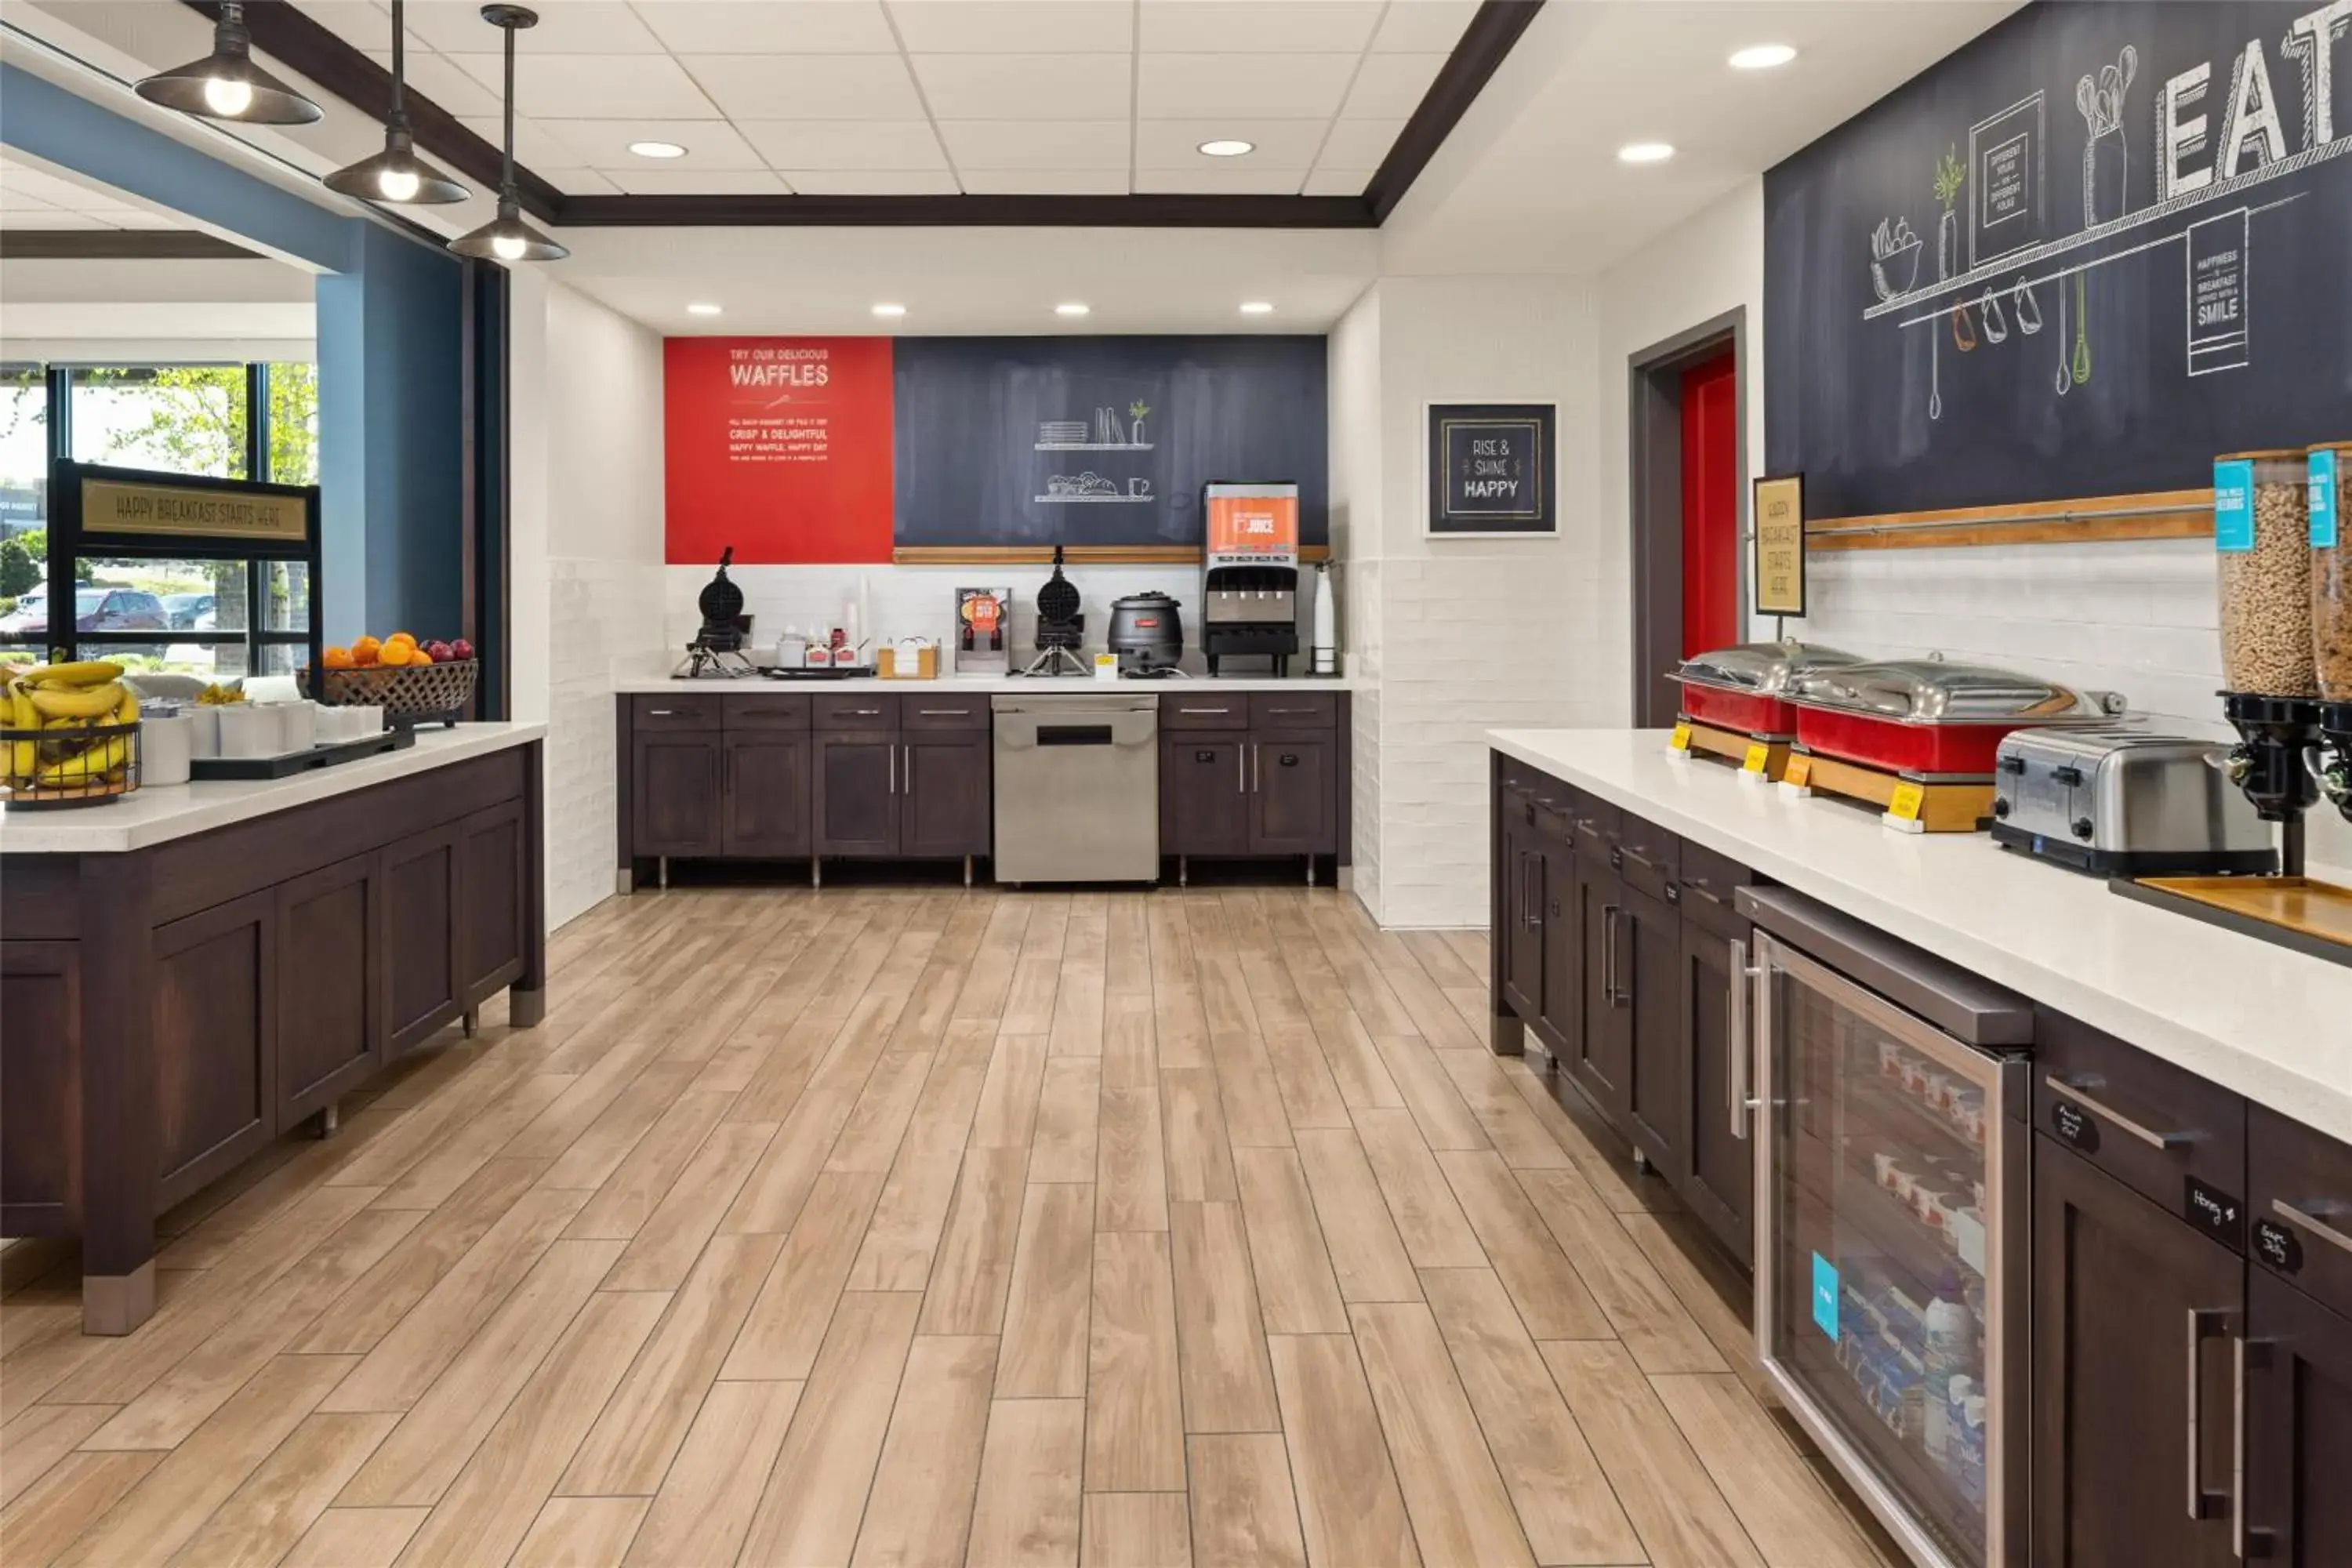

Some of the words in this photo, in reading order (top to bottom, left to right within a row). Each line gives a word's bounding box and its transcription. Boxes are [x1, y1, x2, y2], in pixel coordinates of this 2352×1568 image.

[2156, 0, 2352, 203] EAT
[2198, 249, 2238, 270] HAPPINESS
[2198, 274, 2237, 294] BREAKFAST
[2198, 297, 2238, 325] SMILE
[730, 350, 749, 360] TRY
[753, 350, 775, 360] OUR
[778, 350, 829, 360] DELICIOUS
[730, 364, 829, 387] WAFFLES
[729, 429, 758, 440] CRISP
[771, 429, 827, 440] DELIGHTFUL
[1473, 440, 1497, 456] RISE
[1500, 439, 1510, 456] &
[1475, 459, 1507, 476] SHINE
[1465, 481, 1519, 498] HAPPY
[117, 495, 154, 521] HAPPY
[157, 498, 216, 523] BREAKFAST
[219, 503, 253, 524] STARTS
[1247, 519, 1274, 534] JUICE
